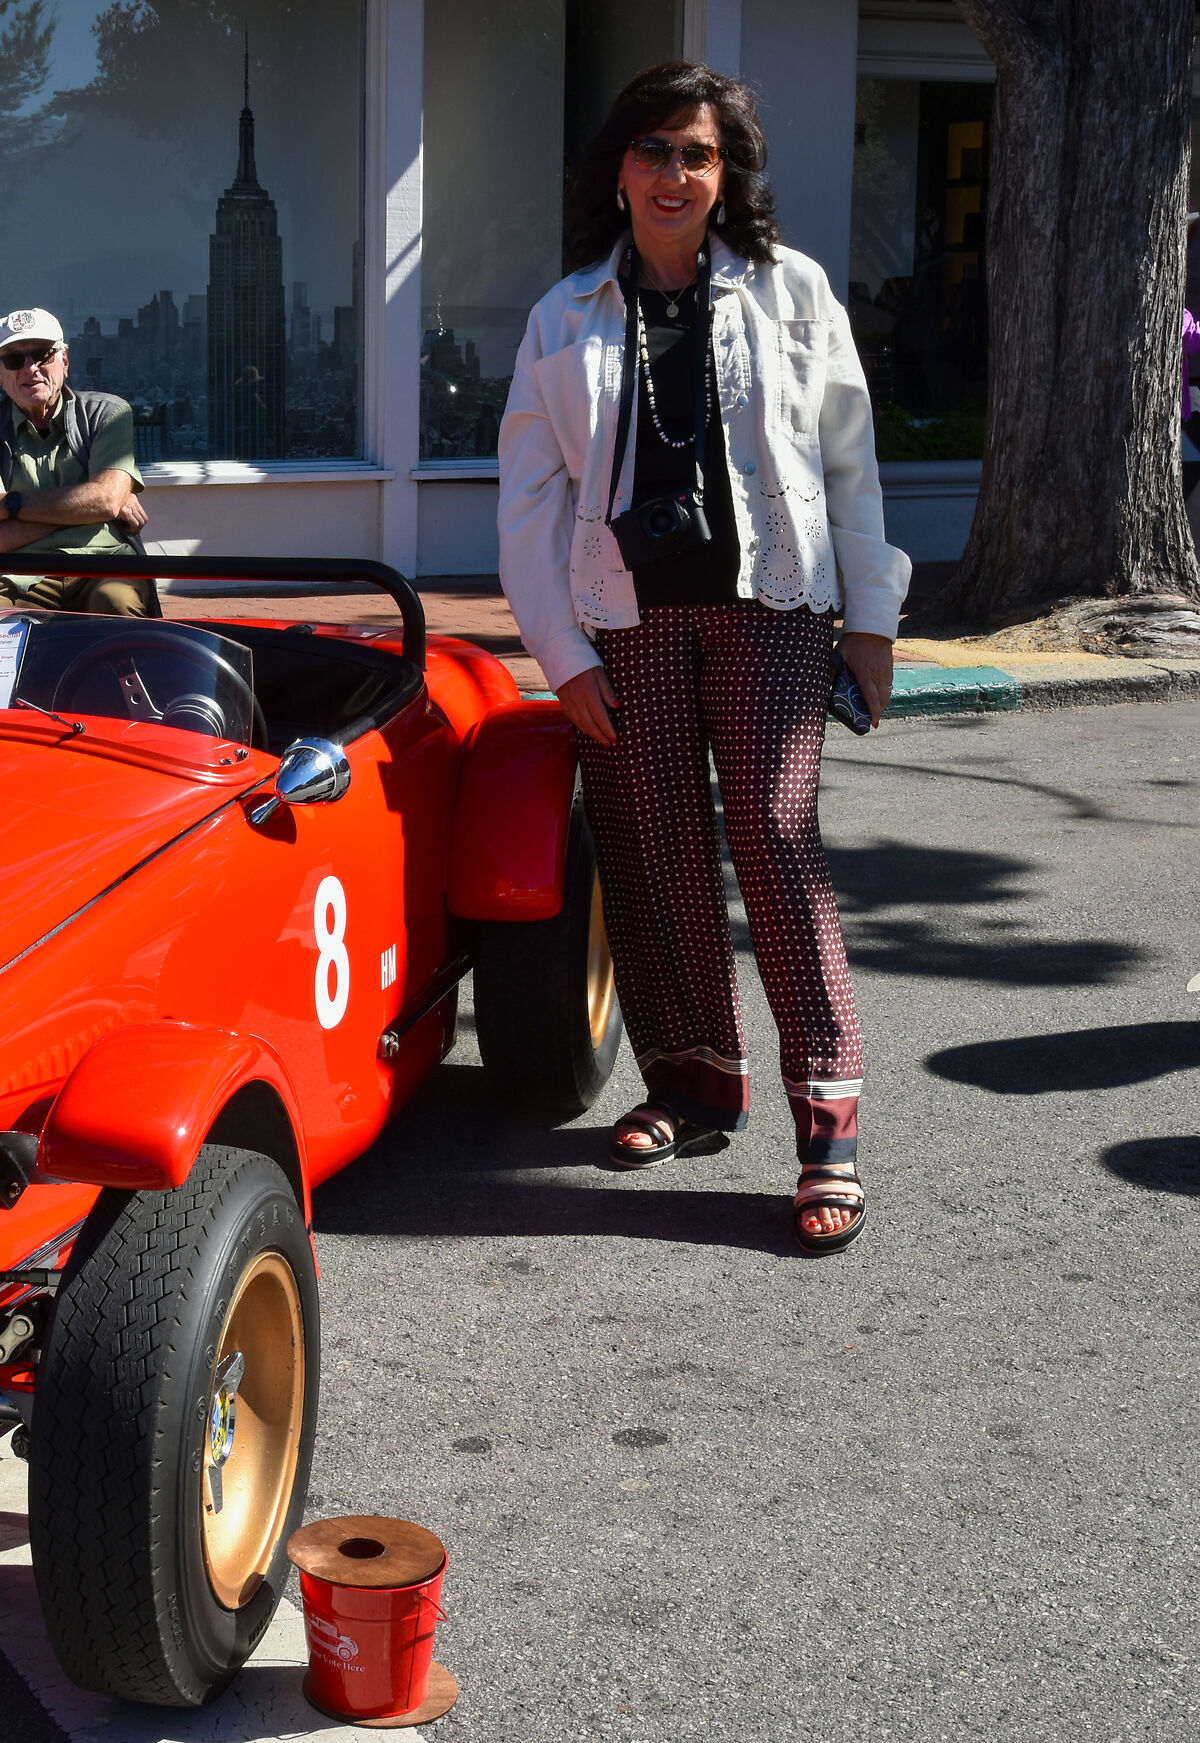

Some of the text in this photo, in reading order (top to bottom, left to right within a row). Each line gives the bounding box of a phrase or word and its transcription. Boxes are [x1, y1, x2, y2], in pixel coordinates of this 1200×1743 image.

[313, 873, 350, 1030] 8
[323, 1653, 342, 1669] Vote
[343, 1662, 366, 1673] Here
